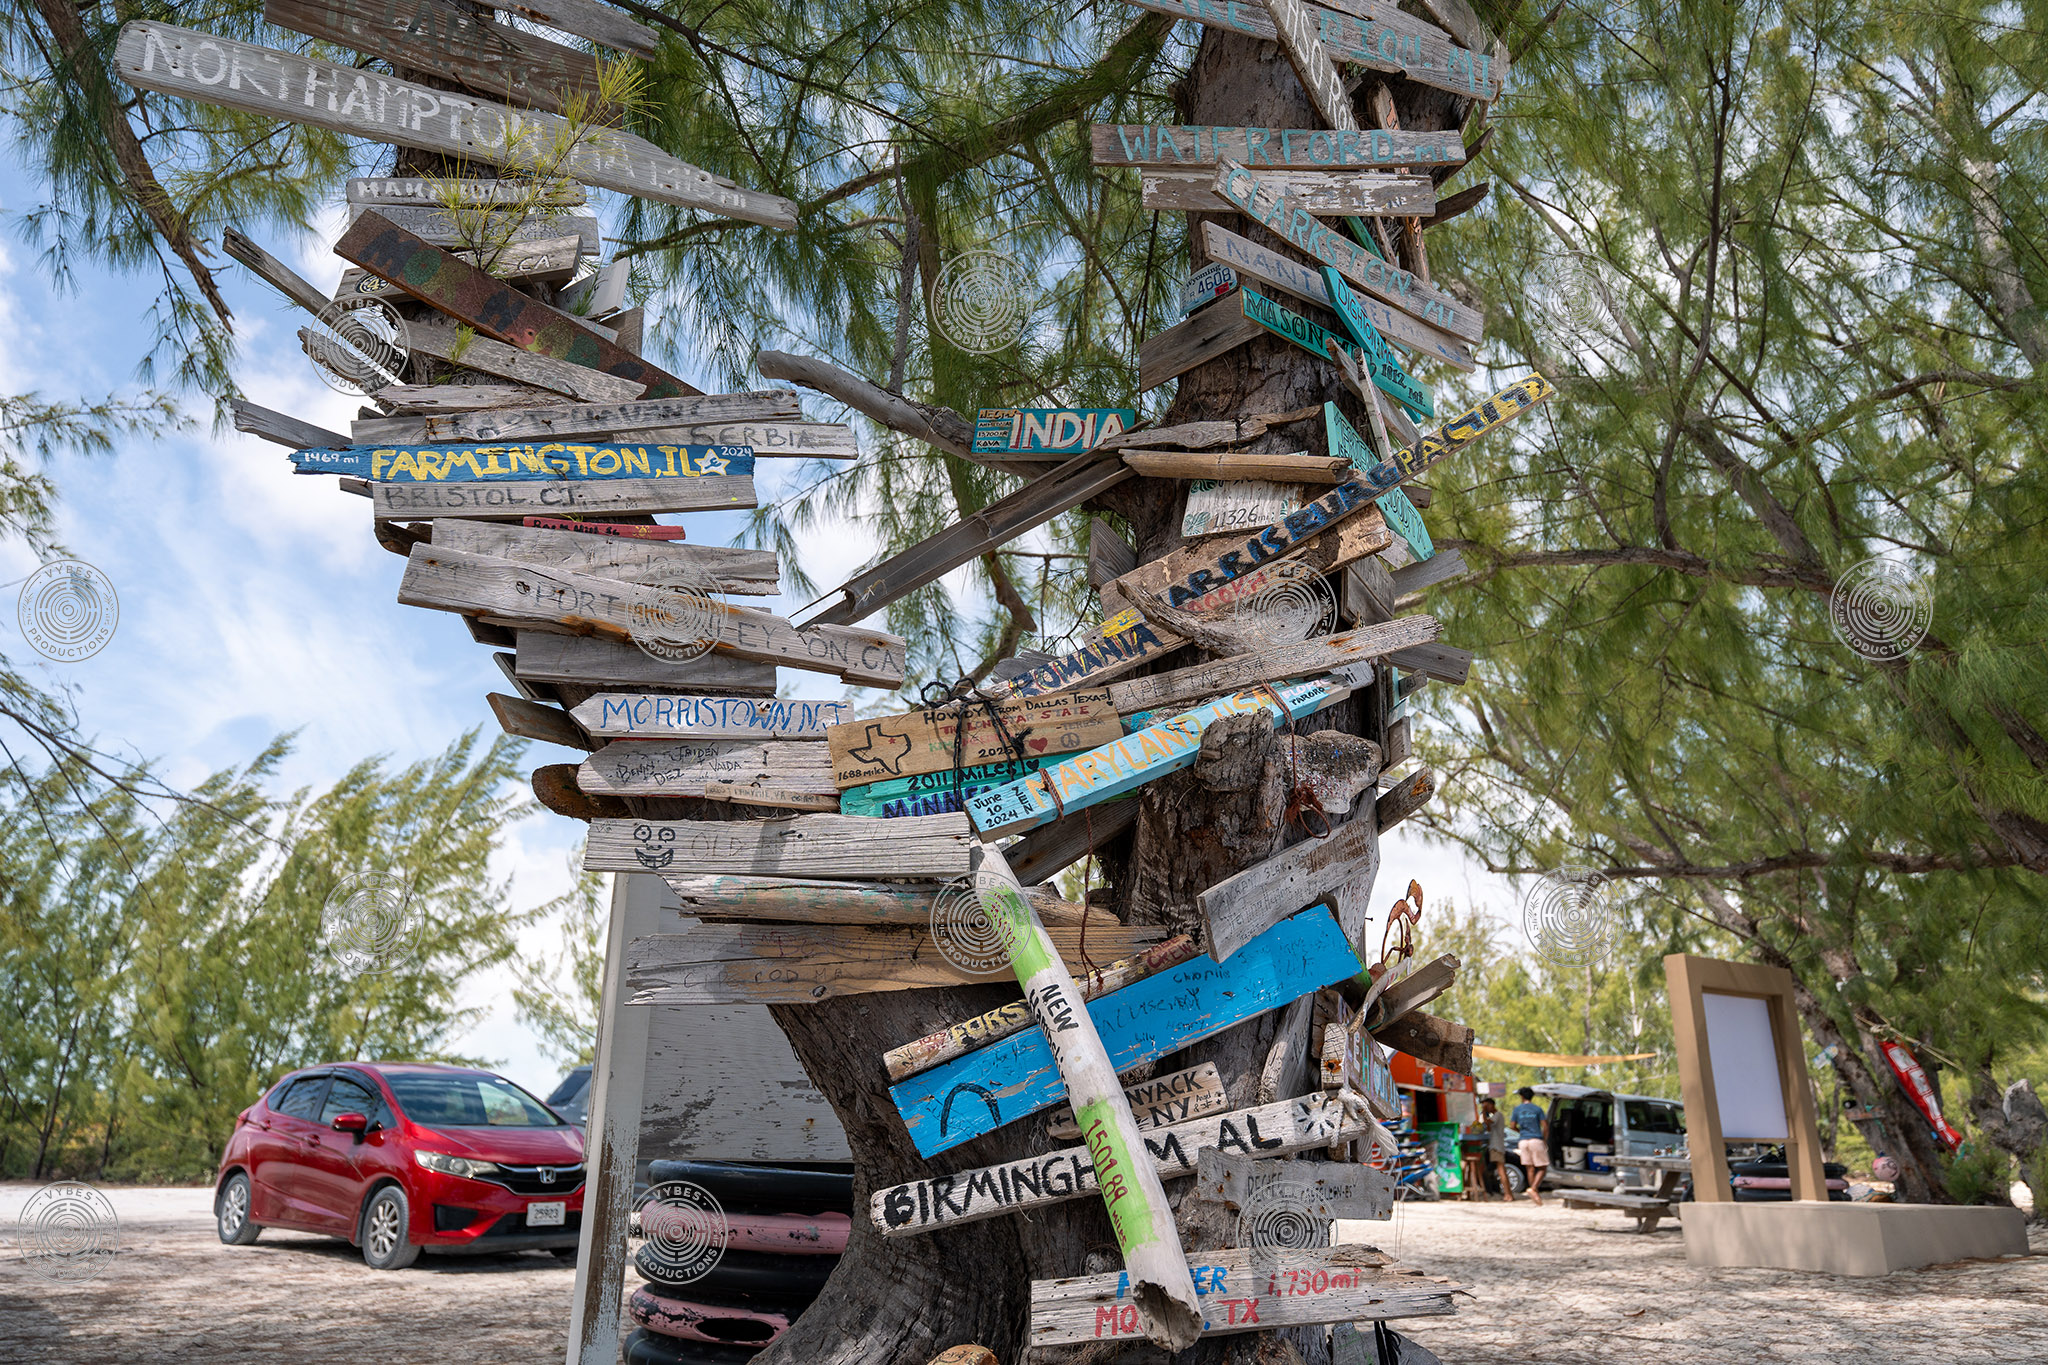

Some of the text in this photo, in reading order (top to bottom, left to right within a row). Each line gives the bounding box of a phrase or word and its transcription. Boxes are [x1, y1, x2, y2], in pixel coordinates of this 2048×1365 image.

[1422, 298, 1456, 330] MI
[690, 426, 811, 449] SERBIA
[1009, 411, 1125, 450] INDIA
[303, 452, 360, 465] 1469 mi
[720, 445, 753, 458] 2024
[1158, 462, 1401, 609] ARRISBURG
[535, 582, 621, 618] PORT
[1008, 622, 1164, 699] ROMANIA
[1025, 698, 1072, 711] DALLAS
[939, 723, 961, 736] TH
[1040, 704, 1090, 720] STATE
[1026, 712, 1205, 808] MARYLAND
[838, 770, 862, 781] 1688
[907, 774, 949, 792] 2011
[973, 792, 1002, 810] June
[985, 804, 1003, 816] 10
[985, 809, 1019, 829] 2024
[1146, 941, 1193, 970] CREW
[1039, 983, 1080, 1033] NEW
[1126, 1072, 1204, 1107] NYACK
[1149, 1096, 1194, 1128] NY
[883, 1114, 1283, 1229] BIRMINGHM AL
[1216, 1297, 1260, 1326] TX
